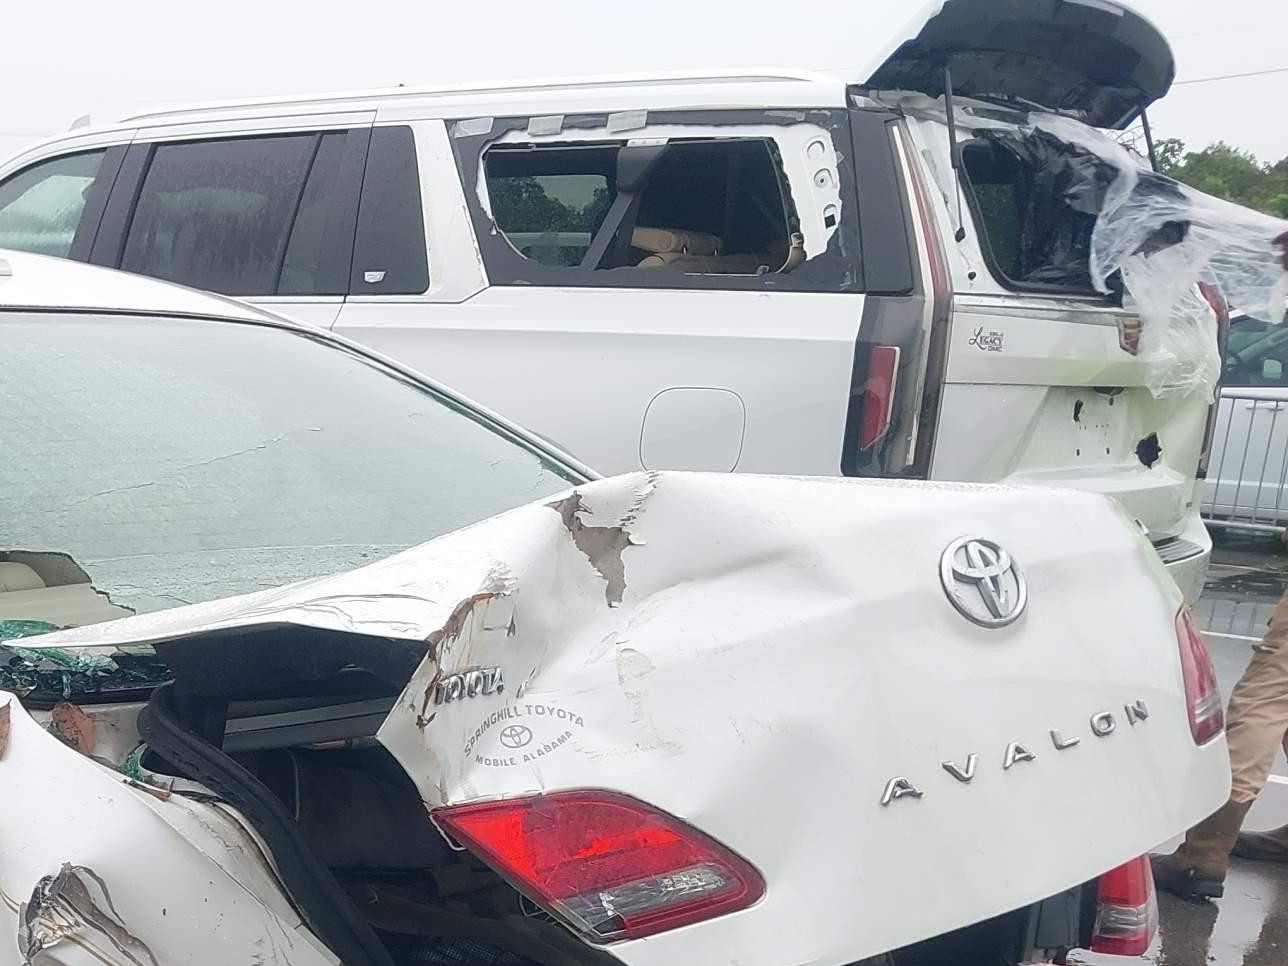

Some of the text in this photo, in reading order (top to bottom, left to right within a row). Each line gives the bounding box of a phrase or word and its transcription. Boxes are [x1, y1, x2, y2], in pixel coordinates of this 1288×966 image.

[434, 667, 505, 705] TOYOTA
[464, 704, 584, 757] SPRINGHILL TOYOTA
[475, 730, 574, 767] MOBILE ALABAMA
[879, 700, 1150, 806] AVALON
